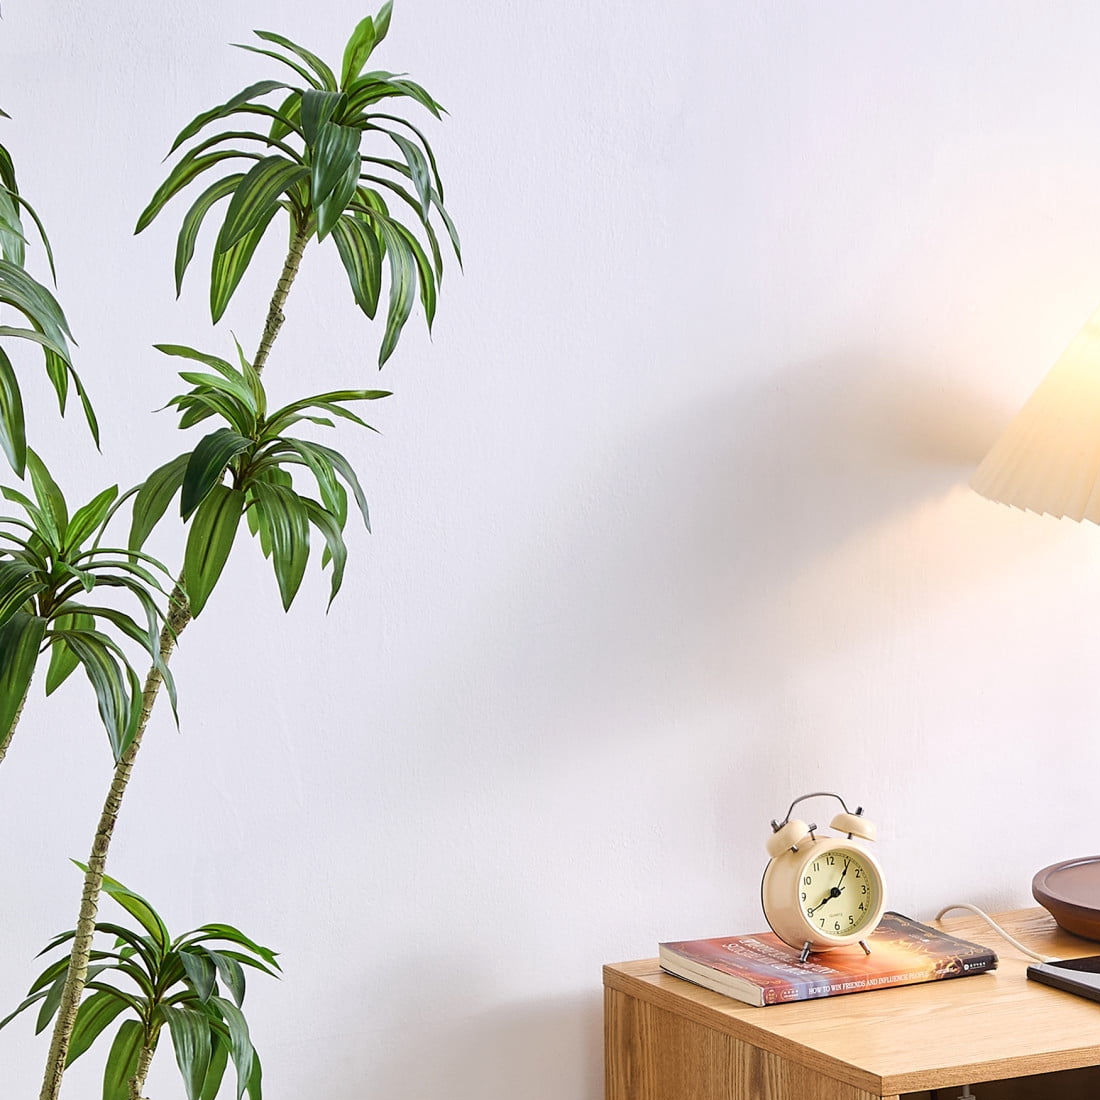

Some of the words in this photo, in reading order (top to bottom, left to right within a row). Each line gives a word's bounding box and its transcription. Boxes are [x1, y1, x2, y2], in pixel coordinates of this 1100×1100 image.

[826, 856, 835, 866] 12
[813, 862, 820, 872] 11
[855, 869, 861, 878] 2
[803, 876, 812, 885] 10
[861, 885, 867, 894] 3
[801, 893, 807, 902] 9
[858, 902, 864, 911] 4
[807, 908, 814, 918] 8
[820, 918, 825, 927] 7
[848, 915, 854, 924] 5
[834, 921, 841, 930] 6
[808, 985, 821, 995] HOW
[822, 985, 830, 993] TO
[831, 983, 842, 992] WIN
[842, 980, 866, 990] FRIENDS
[866, 977, 878, 986] AND
[878, 974, 908, 985] INFLUENCE
